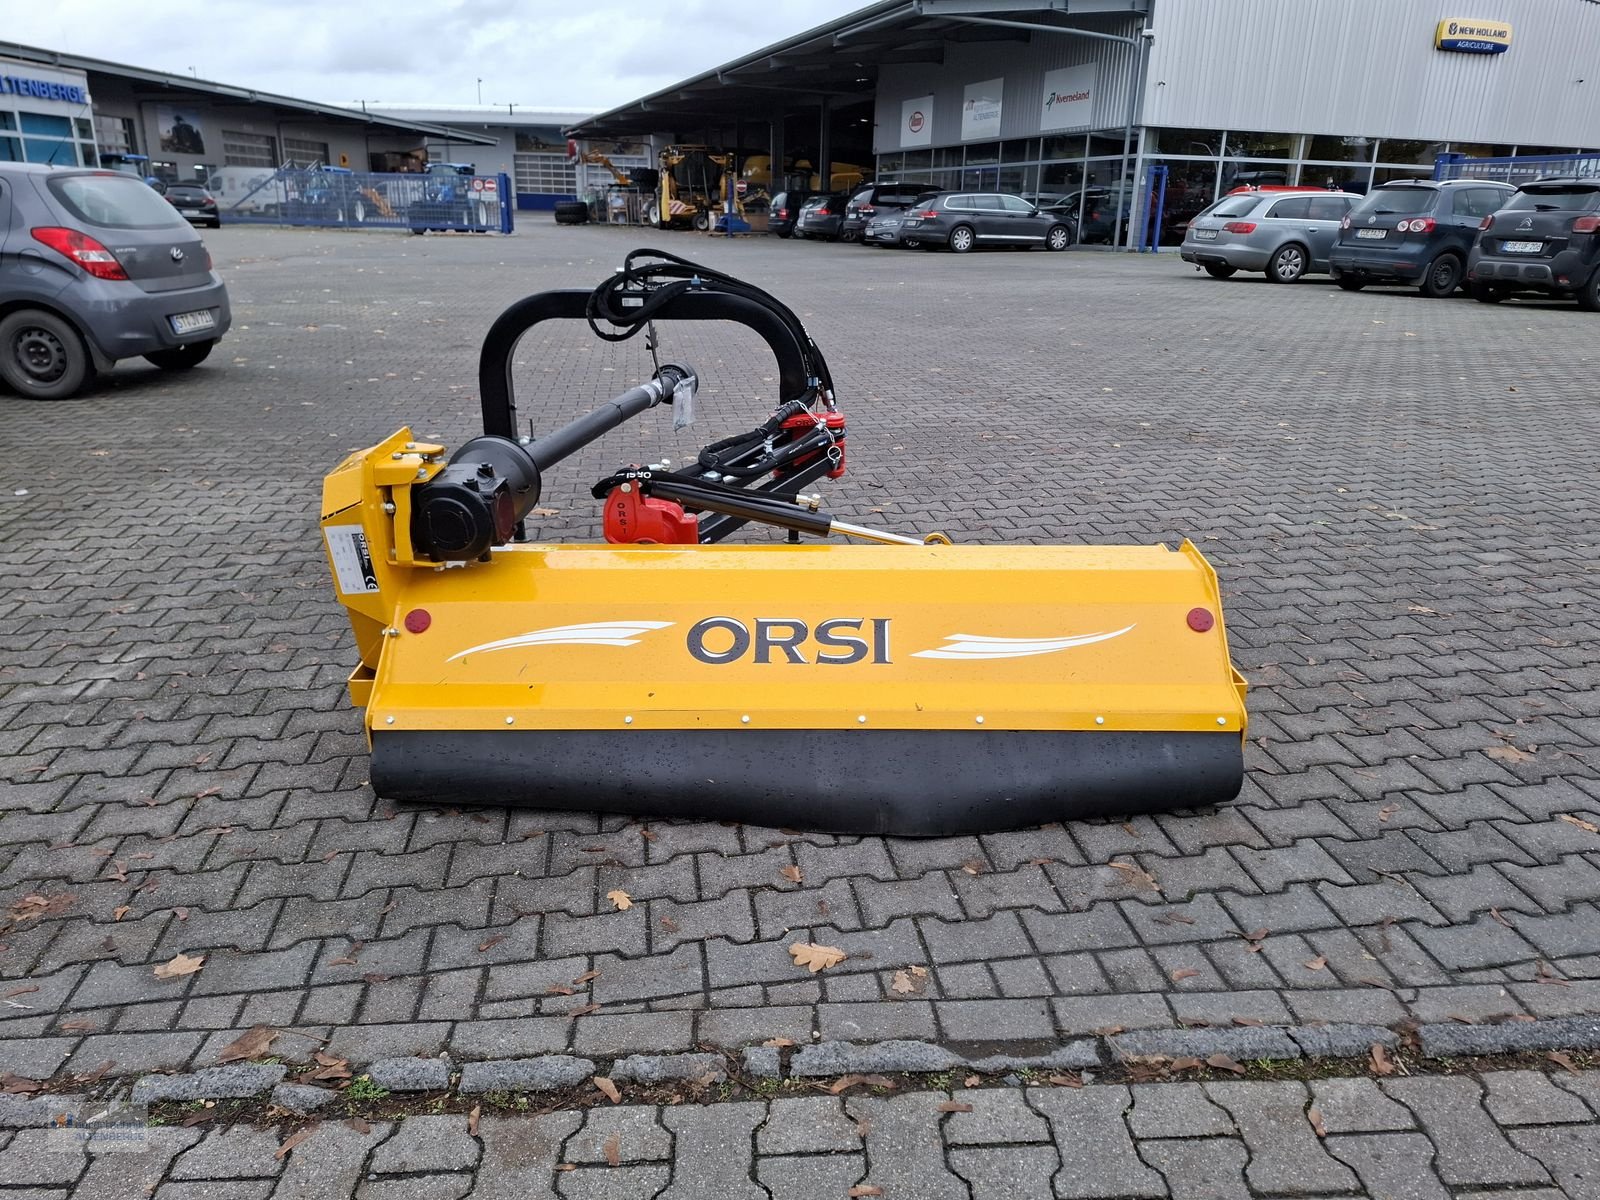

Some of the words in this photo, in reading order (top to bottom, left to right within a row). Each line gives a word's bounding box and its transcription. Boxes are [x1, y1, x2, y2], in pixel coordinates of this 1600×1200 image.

[1459, 26, 1475, 35] NEW
[1476, 28, 1507, 38] HOLLAND
[1457, 41, 1495, 50] AGRICULTURE
[0, 75, 87, 104] LTENBERGE
[1056, 90, 1090, 104] Kverneland
[687, 616, 893, 665] ORSI
